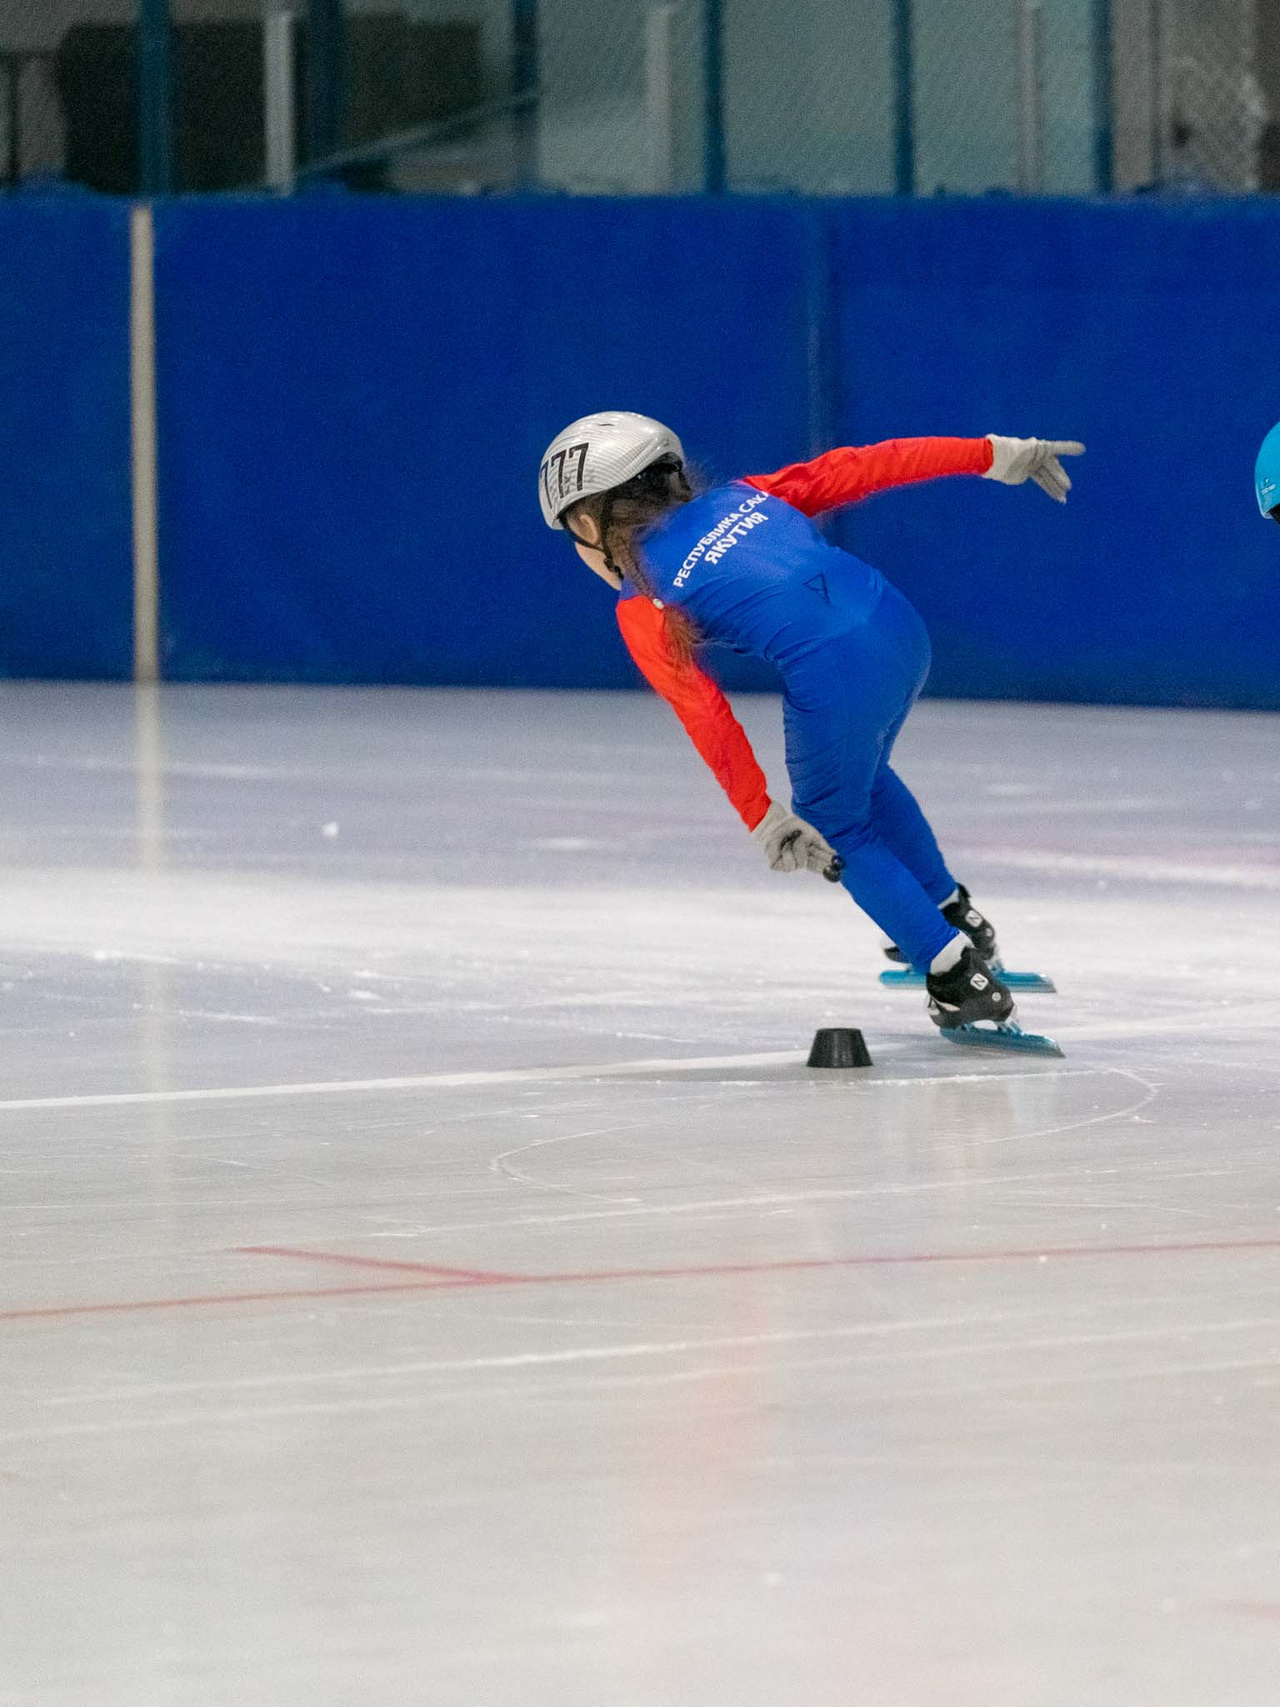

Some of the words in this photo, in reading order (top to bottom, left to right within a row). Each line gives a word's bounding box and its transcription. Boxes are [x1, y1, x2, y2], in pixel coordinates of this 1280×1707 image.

[540, 442, 589, 509] 777
[673, 513, 744, 587] РЕСПУБЛИКА
[704, 512, 769, 565] ЯКУТИЯ
